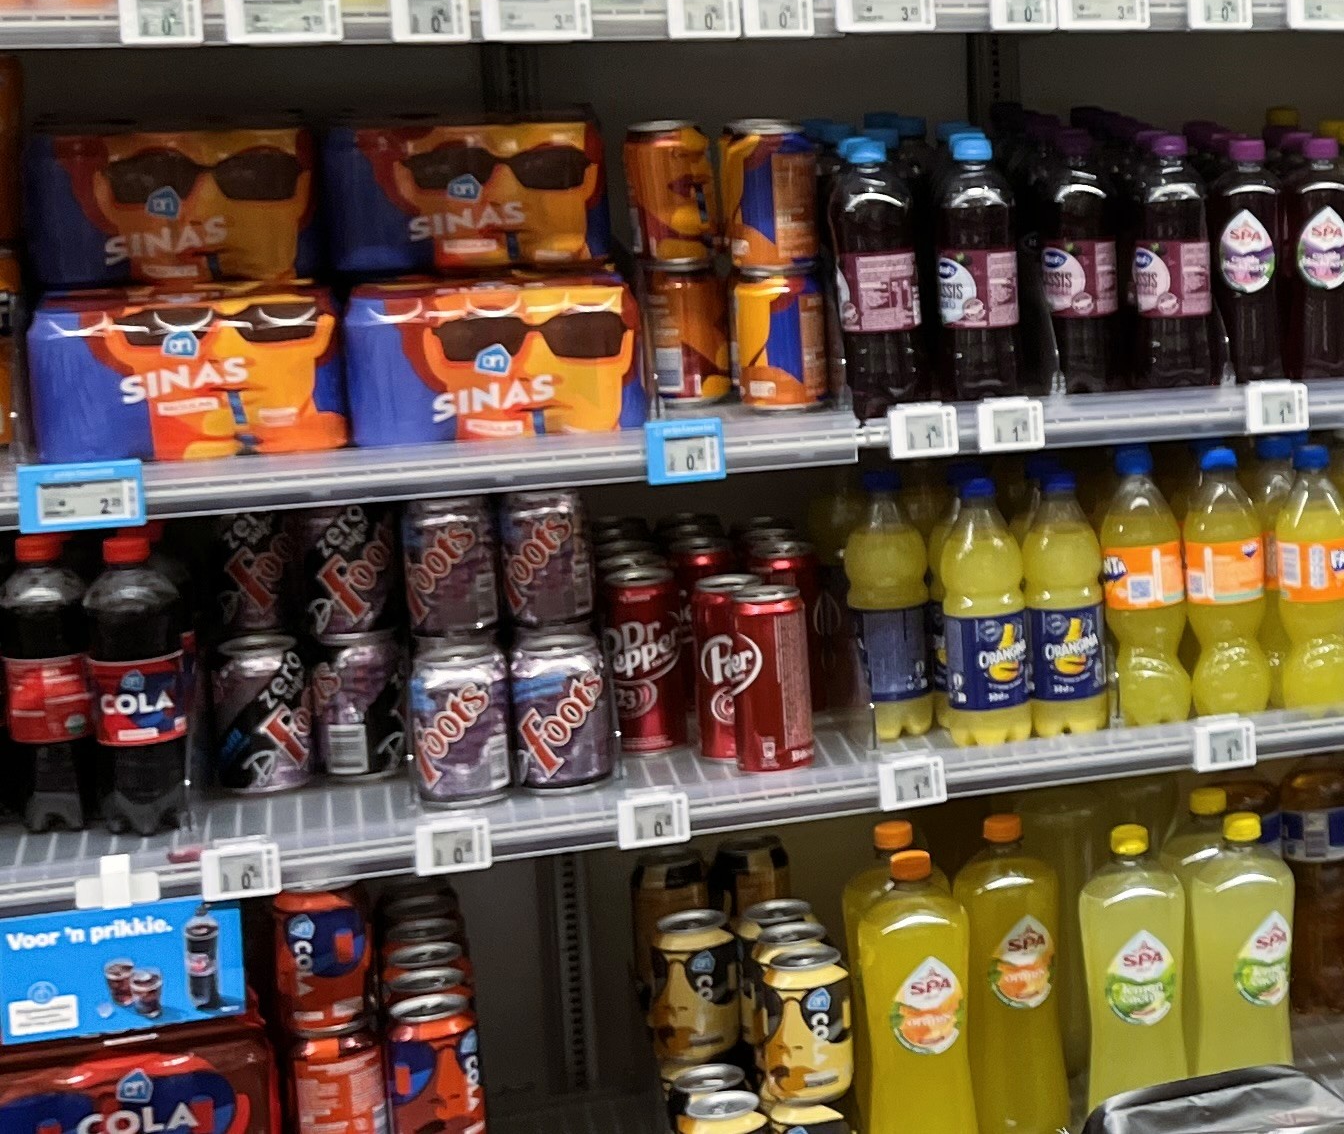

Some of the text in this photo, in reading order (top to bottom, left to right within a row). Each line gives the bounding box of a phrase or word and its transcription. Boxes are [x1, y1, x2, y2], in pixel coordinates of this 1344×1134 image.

[408, 200, 527, 243] SINAS
[104, 213, 229, 265] SINAS
[119, 355, 249, 404] SINAS
[431, 373, 556, 424] SINAS
[100, 689, 176, 716] COLA
[6, 929, 61, 951] Voor
[1007, 932, 1046, 954] SPA
[1123, 950, 1164, 968] SPA
[910, 977, 952, 996] SPA
[77, 1101, 199, 1134] COLA
